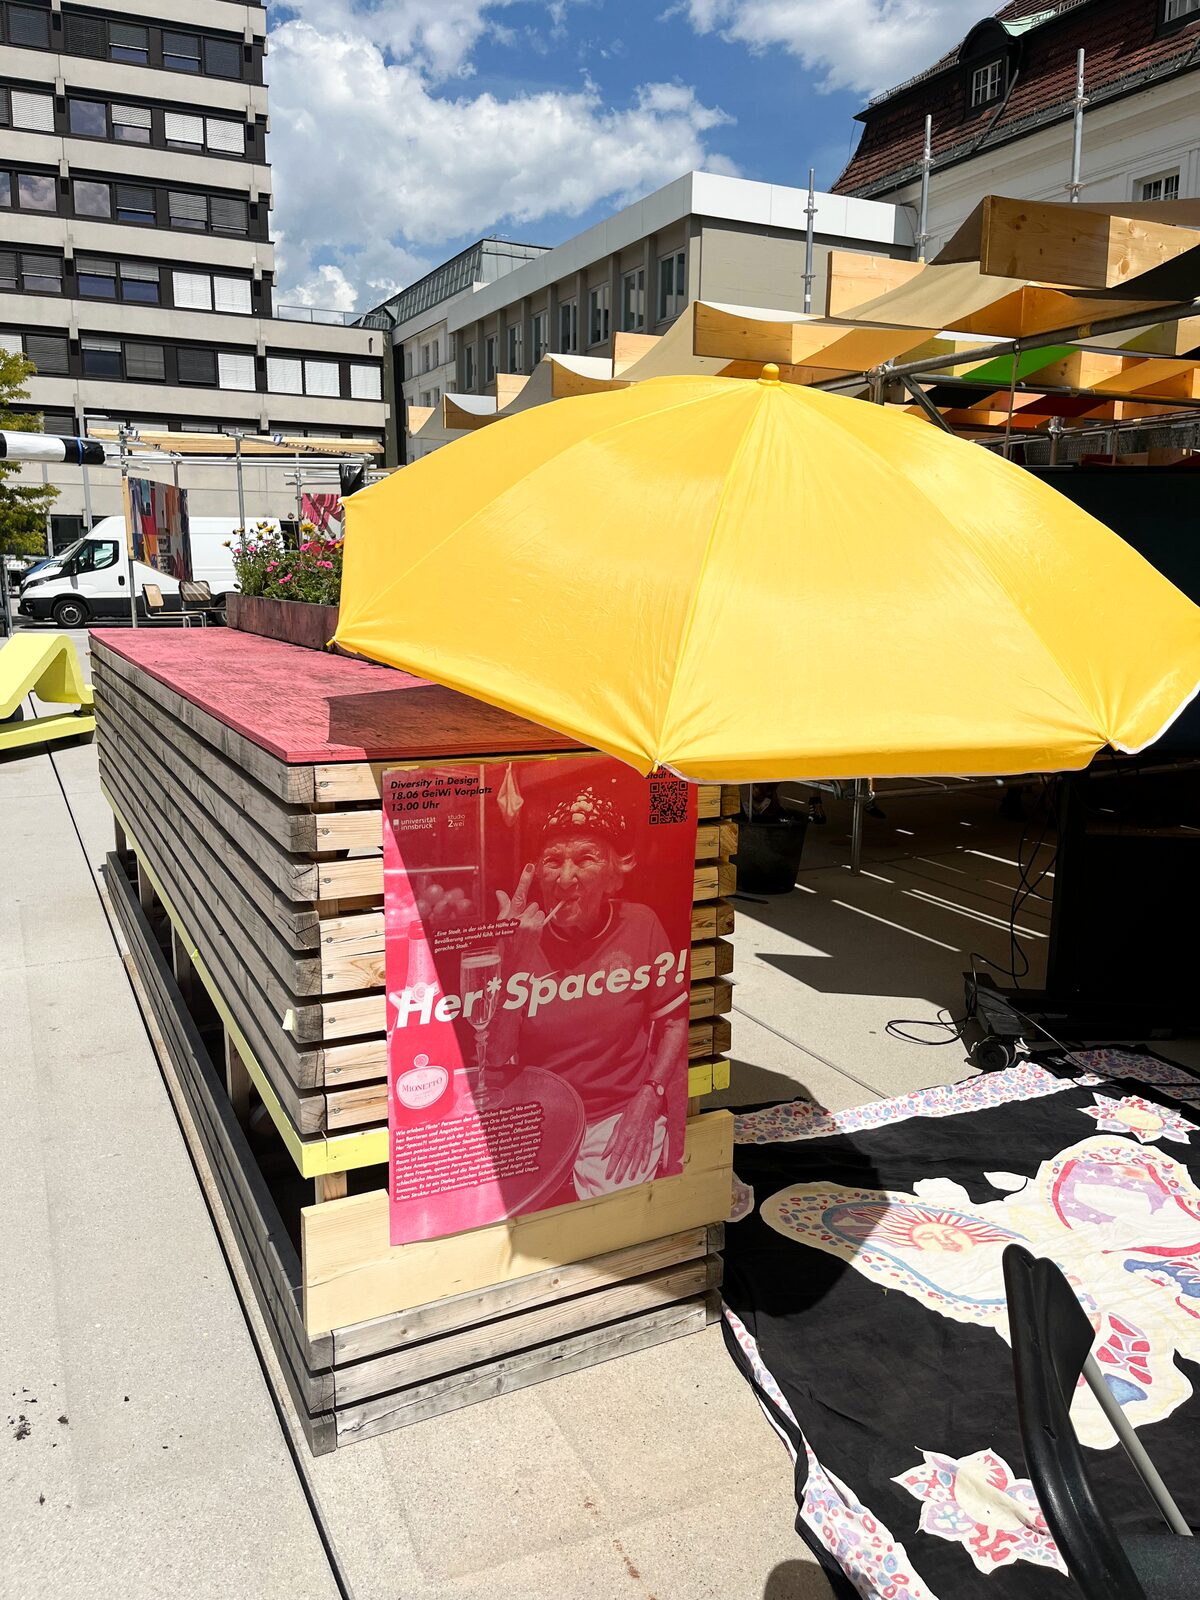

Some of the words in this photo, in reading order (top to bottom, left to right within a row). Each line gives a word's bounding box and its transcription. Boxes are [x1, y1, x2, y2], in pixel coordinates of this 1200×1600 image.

[390, 778, 432, 789] Diversity
[435, 777, 444, 786] in
[447, 776, 478, 786] Design
[392, 790, 418, 800] 18.06
[422, 788, 450, 798] GeiWi
[454, 786, 492, 797] Vorplatz
[392, 802, 419, 812] 13.00
[422, 801, 440, 809] Uhr
[400, 816, 436, 825] universität
[400, 822, 433, 831] innsbruck
